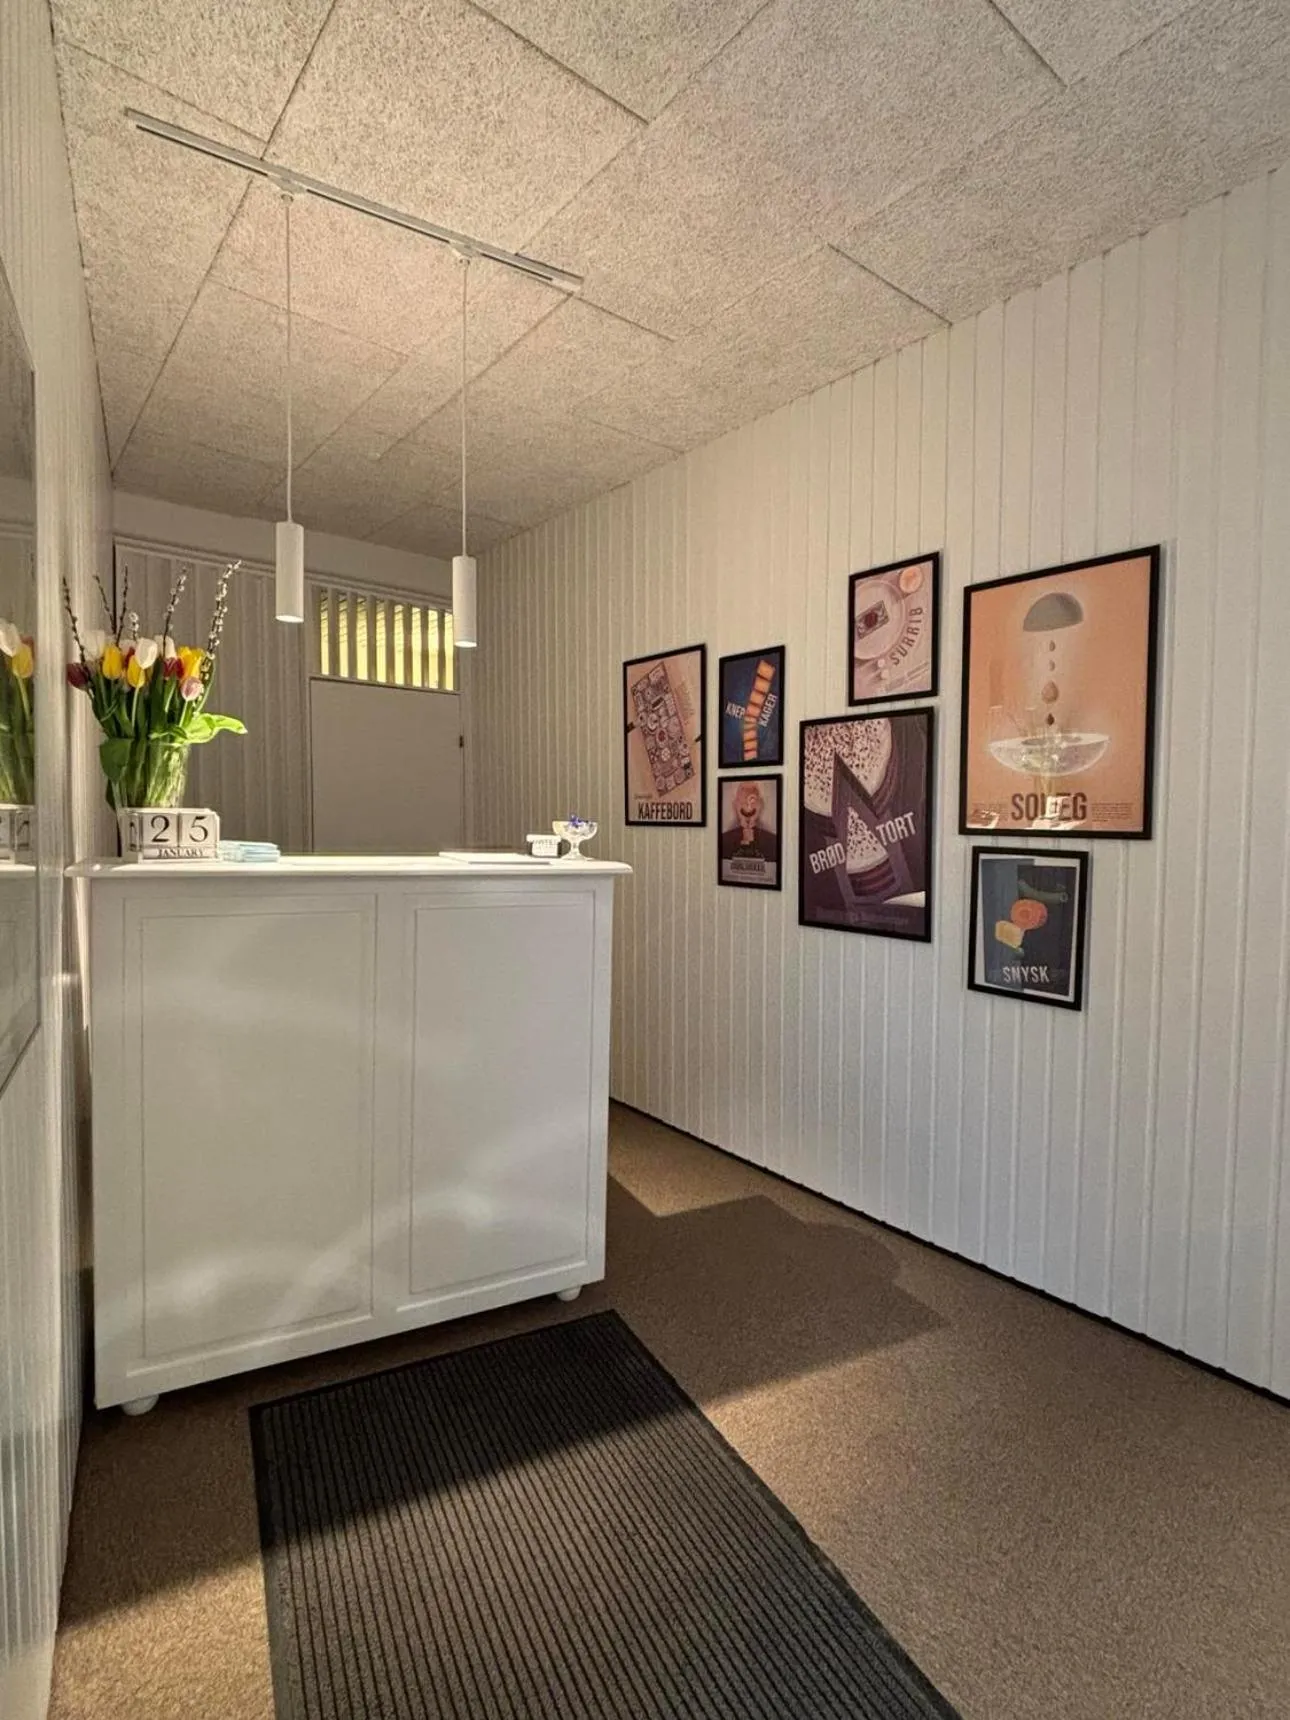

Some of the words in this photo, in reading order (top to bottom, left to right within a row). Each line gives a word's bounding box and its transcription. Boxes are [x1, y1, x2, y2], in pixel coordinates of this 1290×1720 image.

[889, 607, 924, 667] SURRIB
[758, 693, 778, 728] KAGER
[637, 802, 693, 820] KAFFEBORD
[157, 848, 204, 858] JANUARY
[809, 842, 847, 874] BRØD
[875, 811, 916, 846] TORT
[1002, 965, 1050, 983] SNYSK
